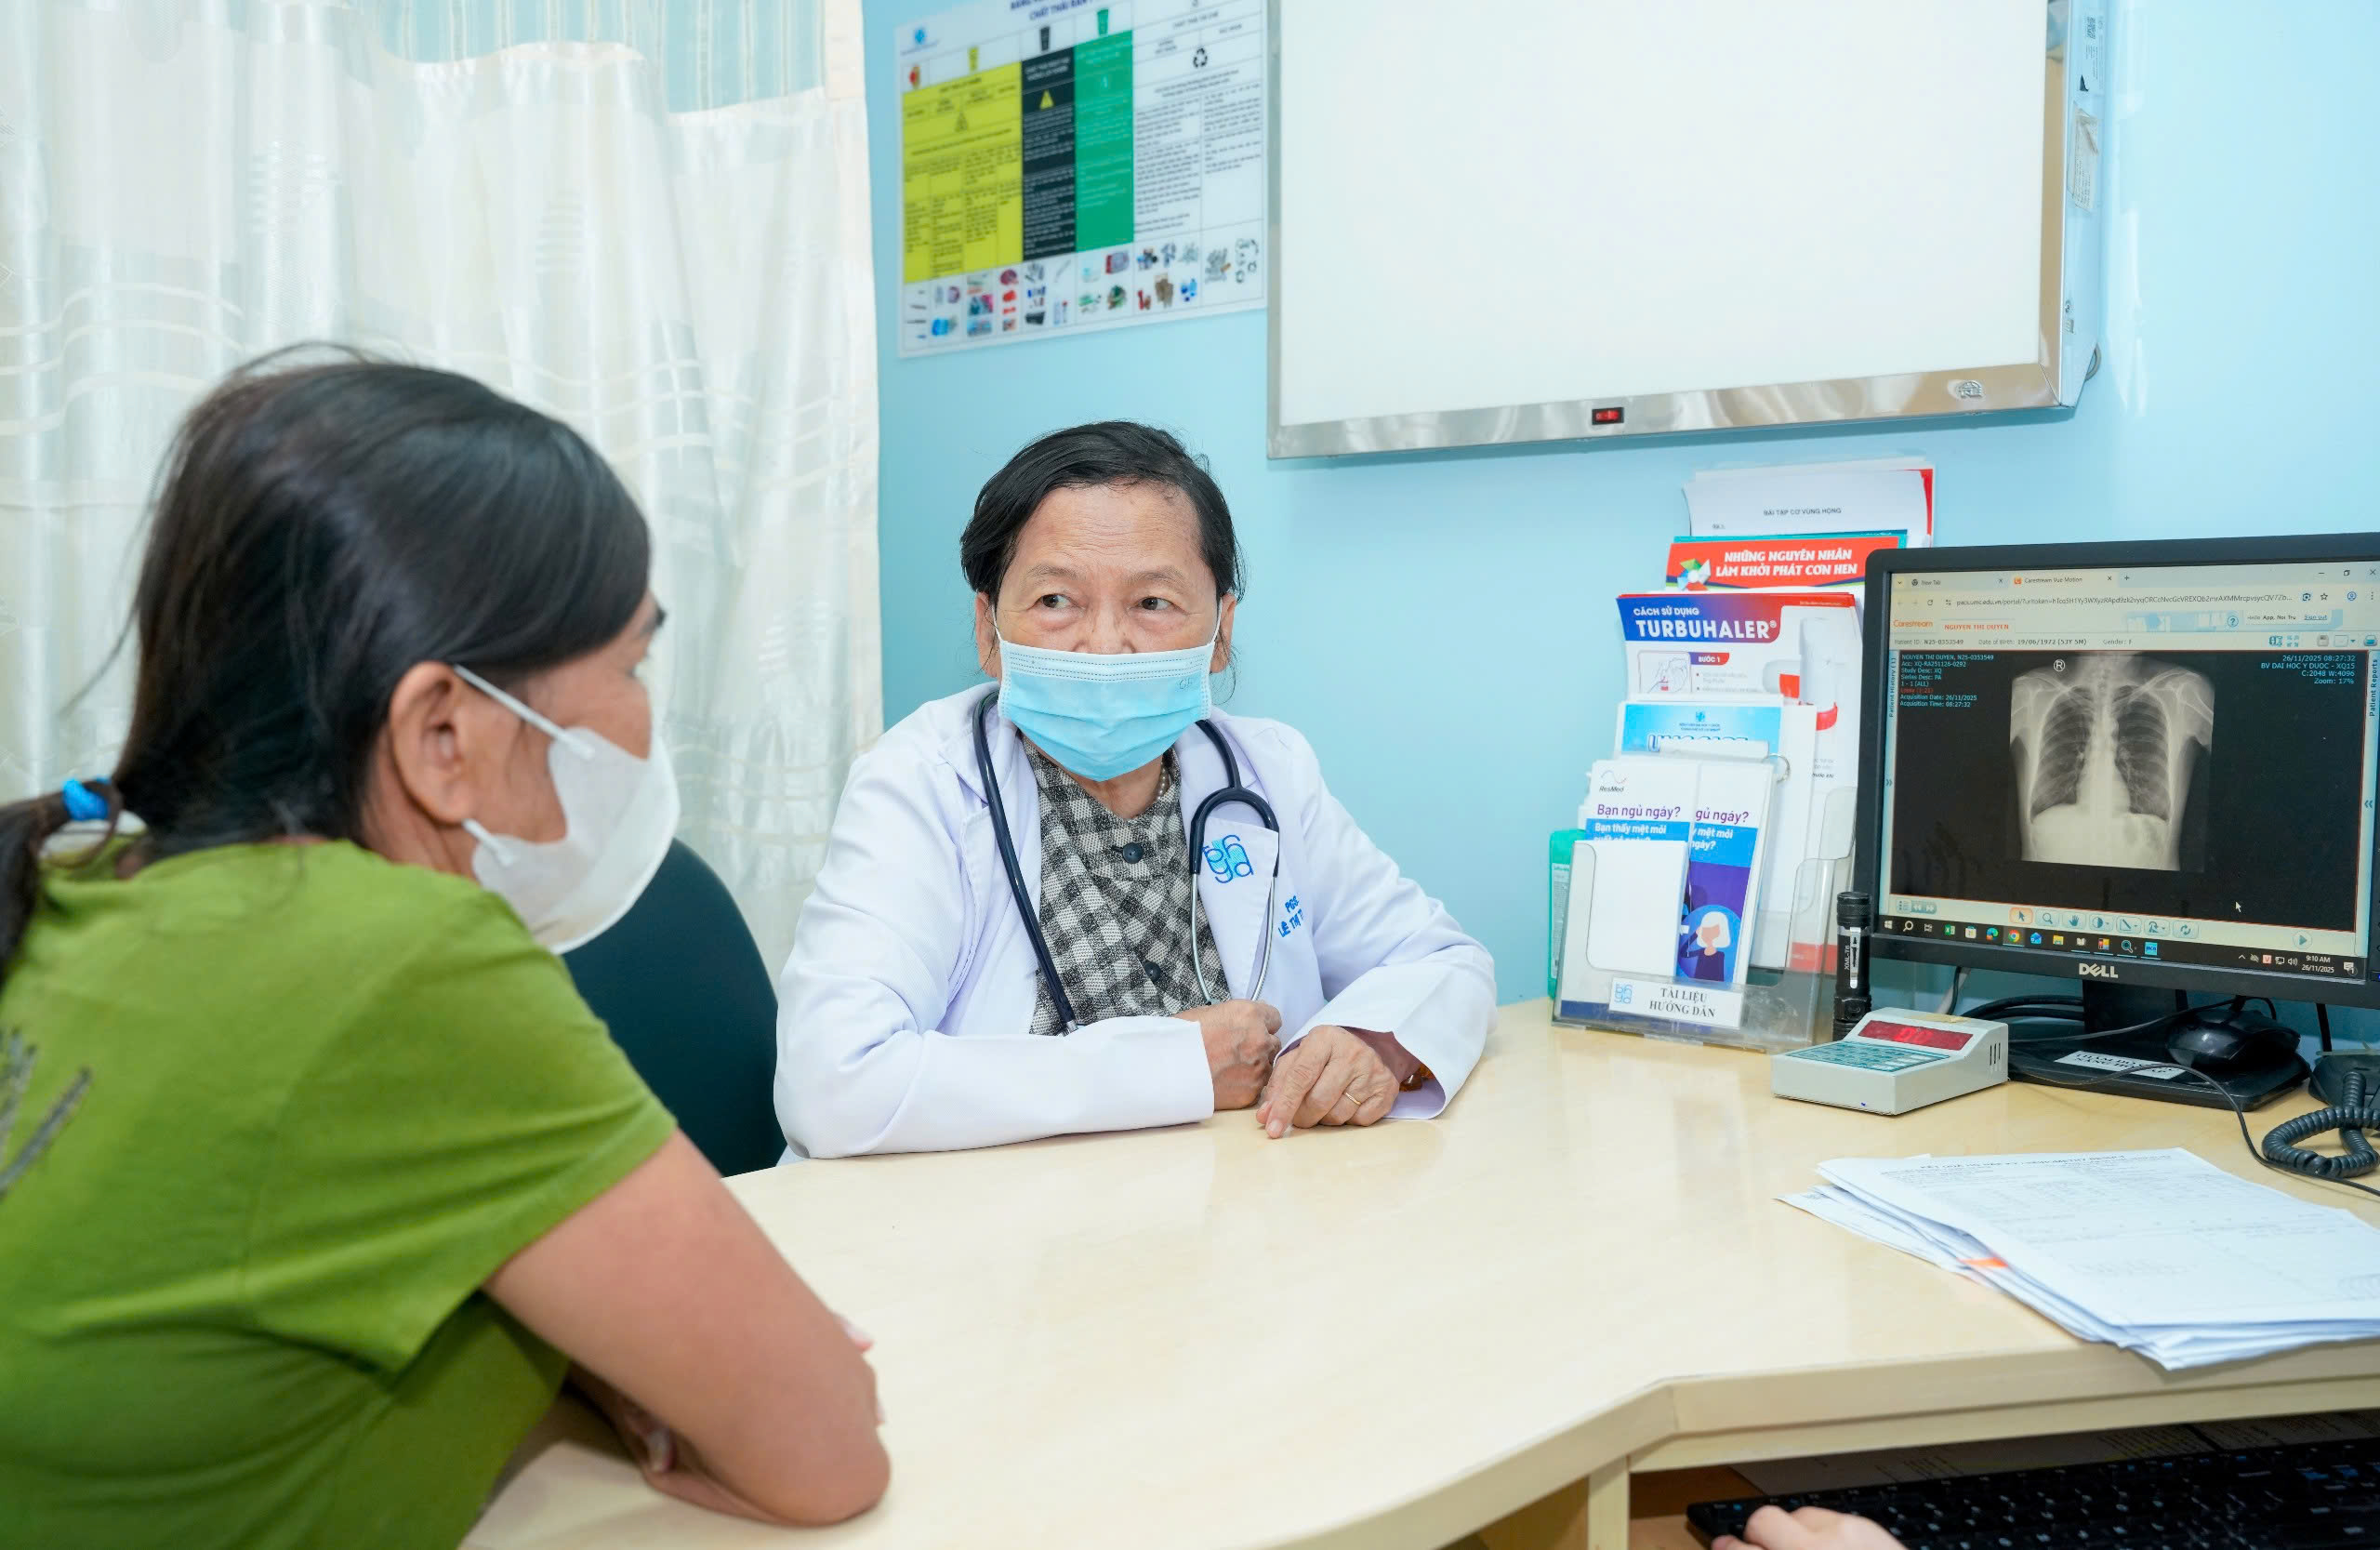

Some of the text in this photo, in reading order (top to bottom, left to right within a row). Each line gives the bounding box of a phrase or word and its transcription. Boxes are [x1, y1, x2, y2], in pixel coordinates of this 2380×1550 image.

[1724, 547, 1852, 563] NHỮNG NGUYÊN NHÂN
[1715, 562, 1858, 576] LÀM KHỞI PHÁT CƠN HEN
[1633, 604, 1699, 618] CÁCH SỬ DỤNG
[1597, 803, 1681, 820] Bạn ngủ ngáy?
[1695, 806, 1750, 825] gủ ngáy?
[1594, 822, 1667, 835] Bạn thấy mệt mỏi
[1698, 828, 1715, 838] mệt
[1716, 828, 1734, 840] mỏi
[2079, 963, 2119, 978] DELL
[2301, 964, 2334, 974] 26/11/2025
[1661, 986, 1709, 1003] TÀI LIỆU
[1649, 1000, 1690, 1014] HƯỚNG
